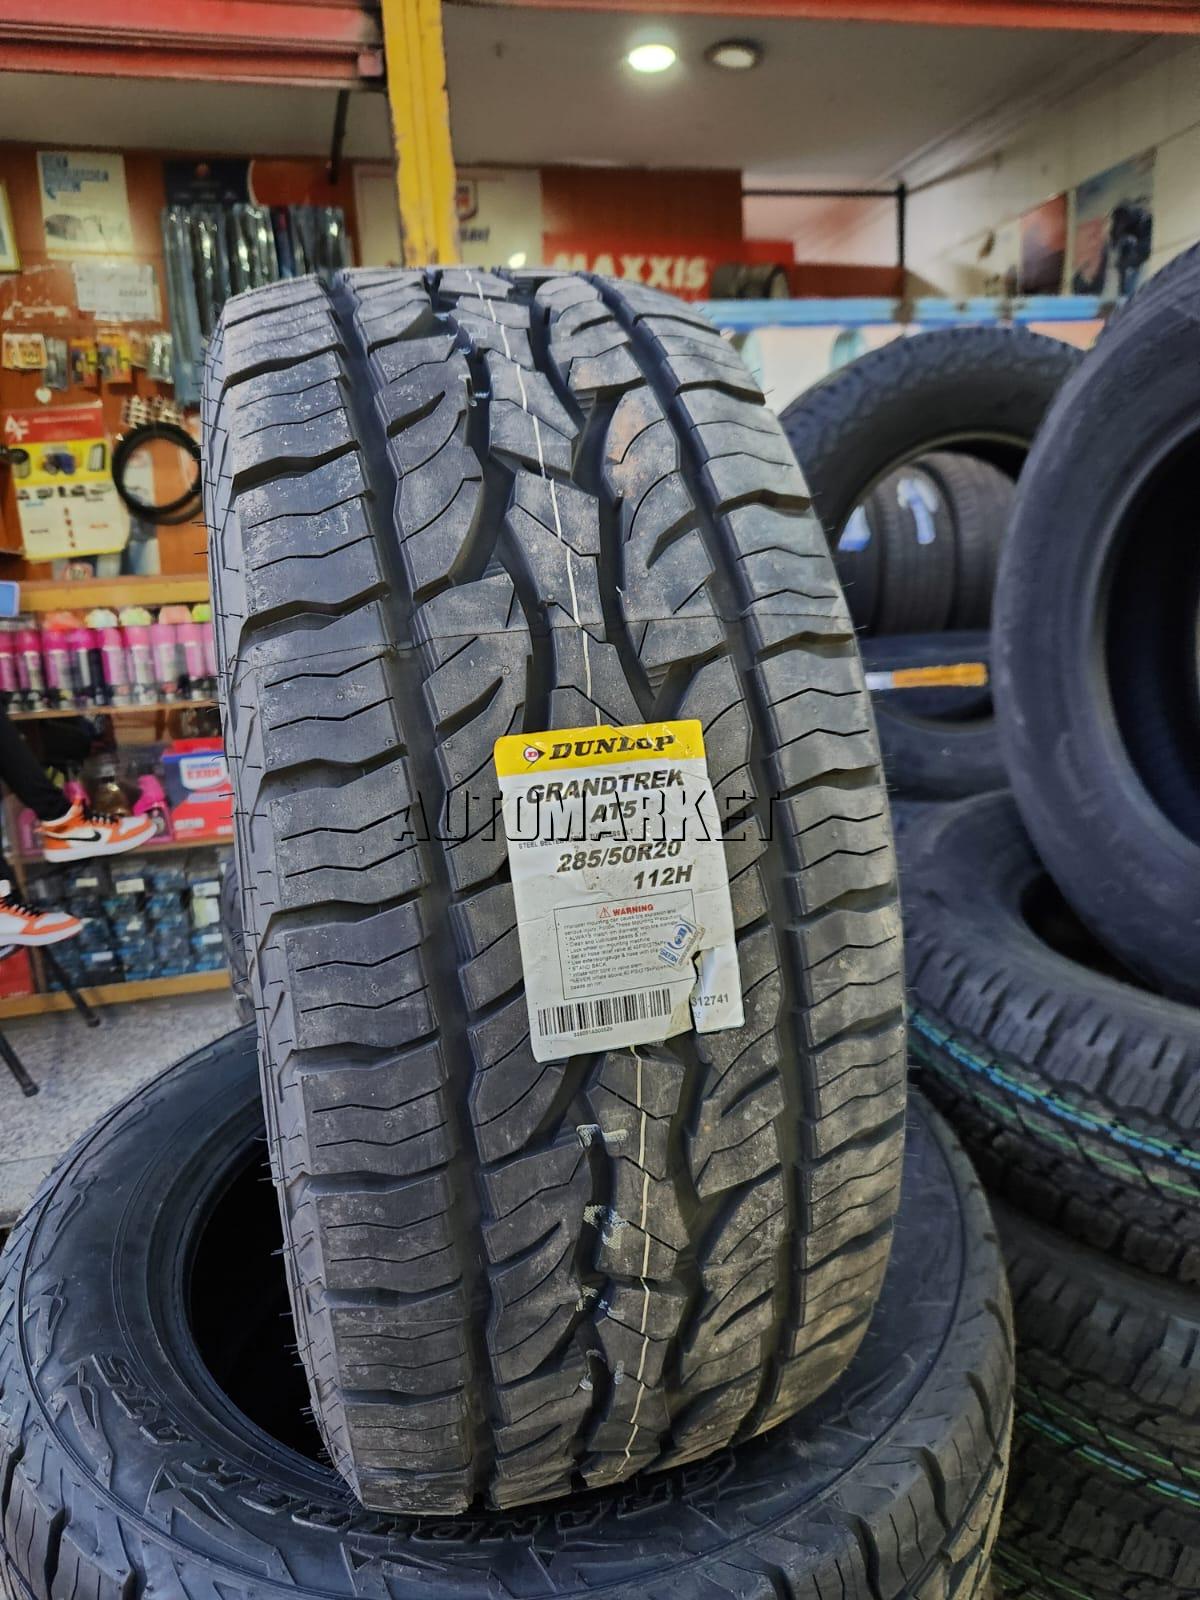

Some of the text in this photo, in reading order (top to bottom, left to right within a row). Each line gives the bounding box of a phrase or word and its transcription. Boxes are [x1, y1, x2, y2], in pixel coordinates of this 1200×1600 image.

[554, 252, 708, 289] MAXXIS
[549, 735, 675, 760] DUNLOP
[526, 769, 685, 804] GRANDTREK
[590, 800, 638, 823] AT5
[556, 841, 682, 873] 285/50R20
[633, 864, 693, 890] 112H
[612, 904, 654, 916] WARNING
[690, 992, 729, 1007] 312741
